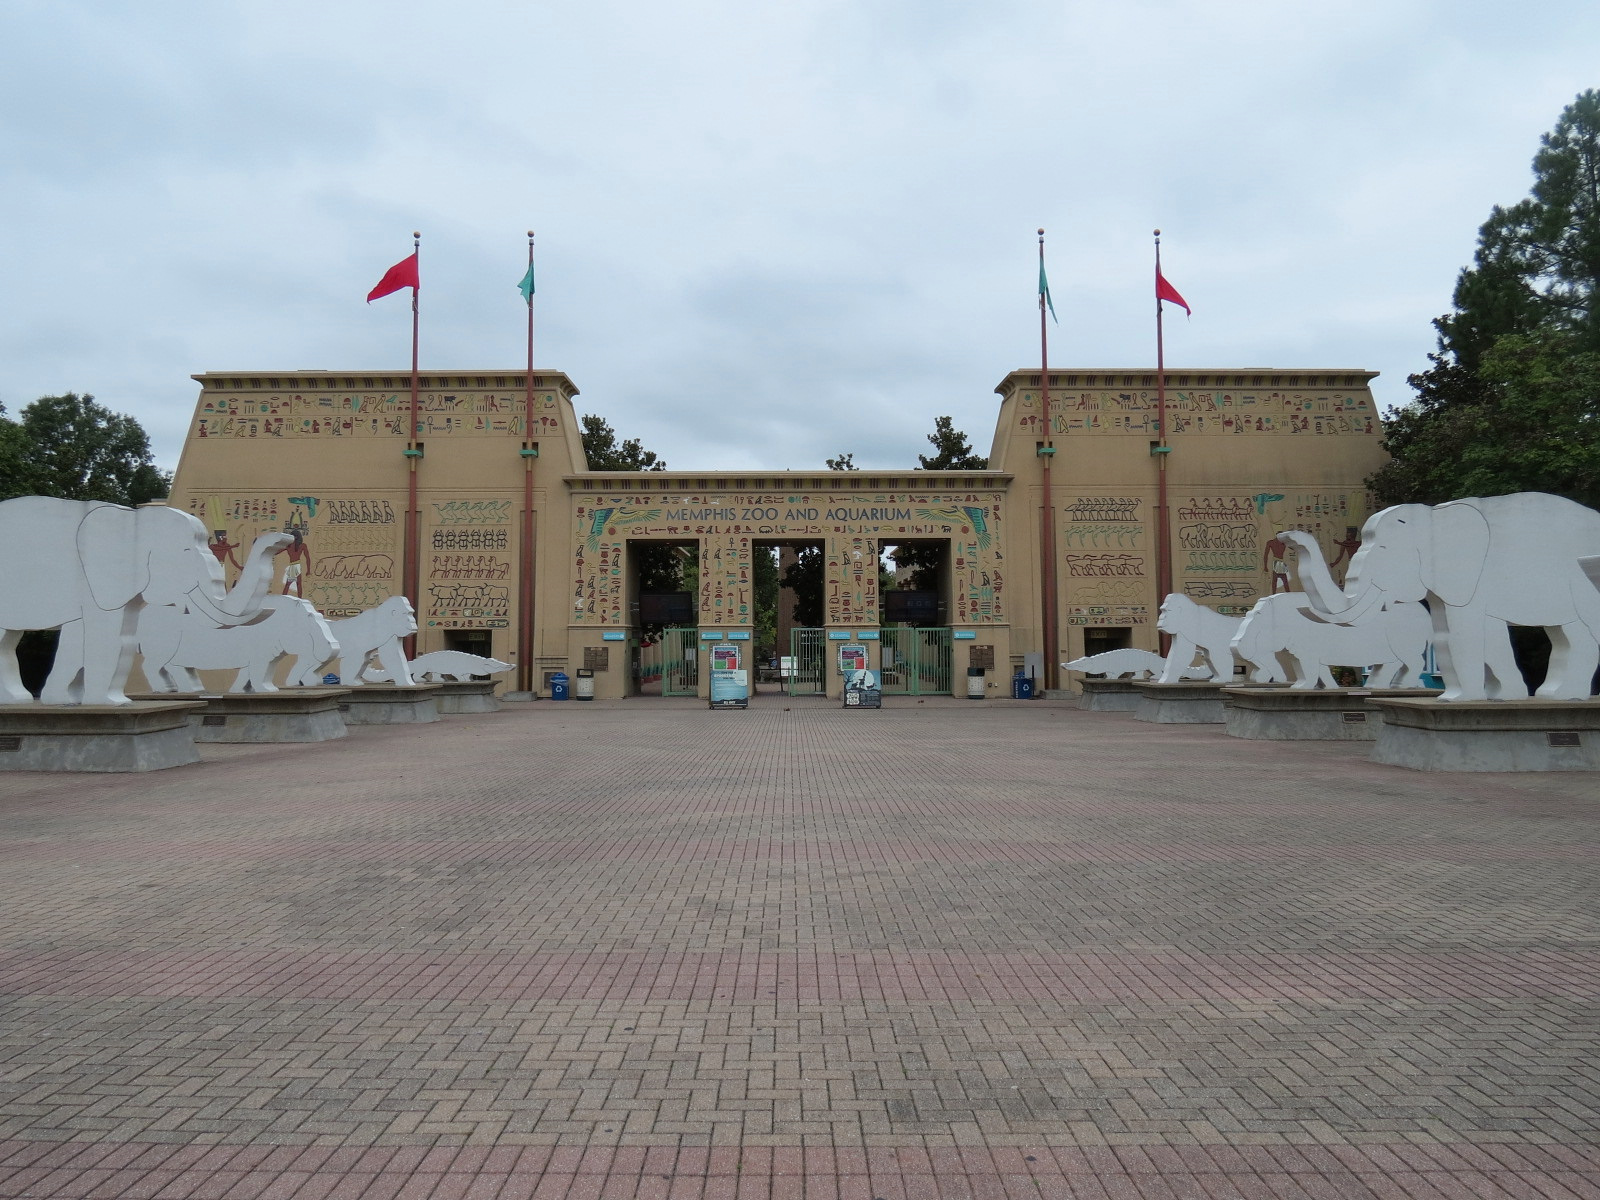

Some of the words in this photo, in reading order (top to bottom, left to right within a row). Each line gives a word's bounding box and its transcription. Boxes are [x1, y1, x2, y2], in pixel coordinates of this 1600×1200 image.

[666, 508, 737, 521] MEMPHIS
[741, 508, 779, 521] ZOO
[785, 508, 819, 521] AND
[825, 508, 911, 522] AQUARIUM
